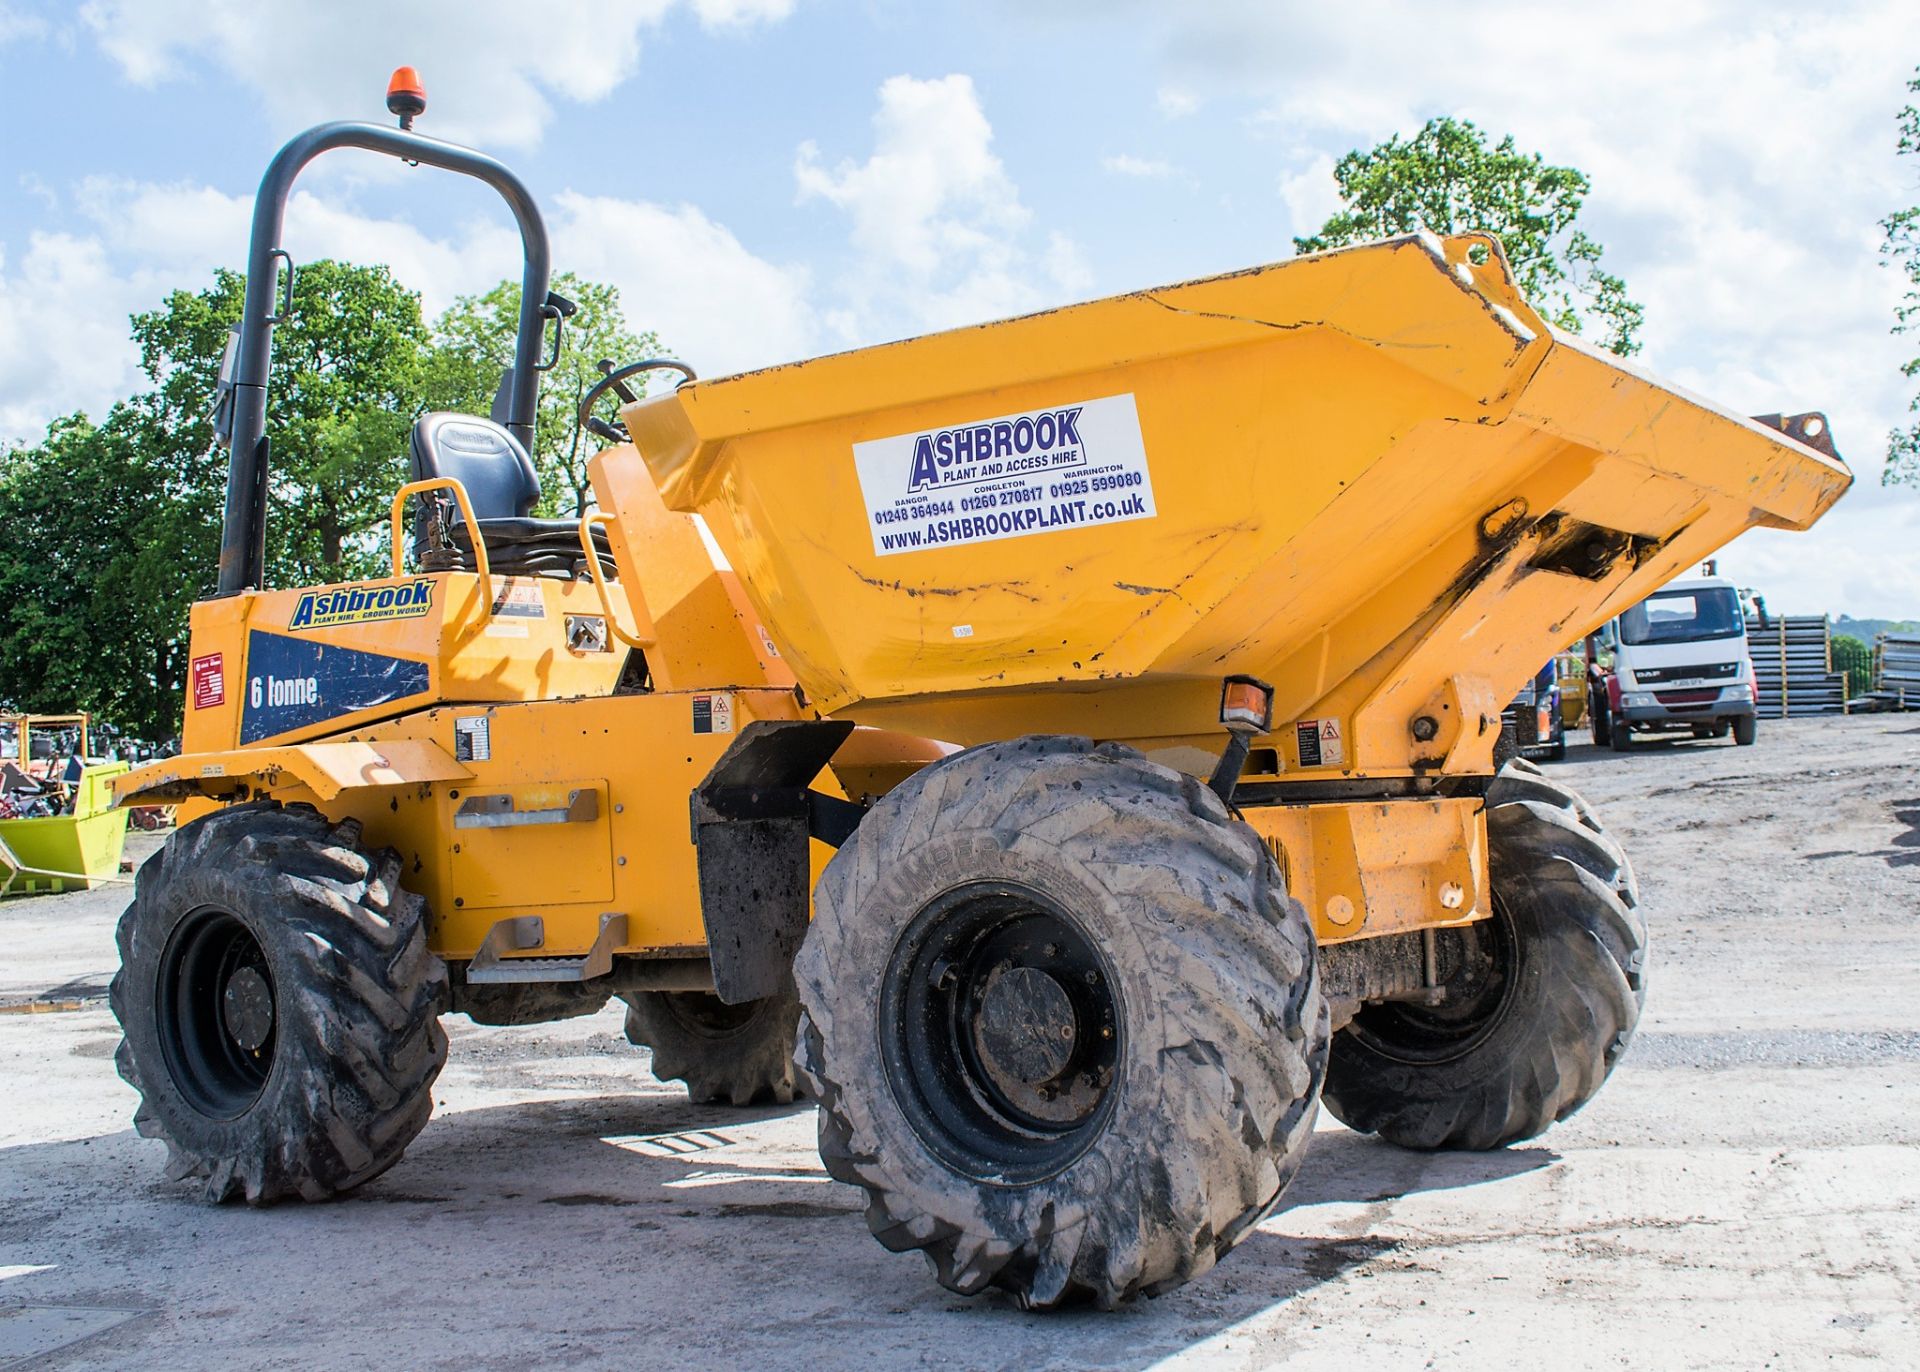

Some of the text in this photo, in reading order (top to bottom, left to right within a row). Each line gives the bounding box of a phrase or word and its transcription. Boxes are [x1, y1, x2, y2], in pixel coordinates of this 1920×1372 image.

[912, 411, 1079, 487] ASHBROOK
[944, 450, 1078, 482] PLANT AND ACCESS HIRE
[1063, 464, 1124, 479] WARRINGTON
[974, 480, 1025, 494] CONGLETON
[1050, 471, 1142, 498] 01925 599080
[895, 495, 928, 506] BANGOR
[961, 487, 1043, 512] 01260 270817
[875, 501, 954, 525] 01248 364944
[293, 581, 430, 626] Ashbrook
[314, 615, 335, 624] PLANT
[338, 613, 354, 621] HIRE
[362, 609, 394, 618] GROUND
[397, 606, 427, 615] WORKS
[1636, 670, 1660, 678] DAF
[251, 676, 263, 709] 6
[268, 675, 318, 707] tonne
